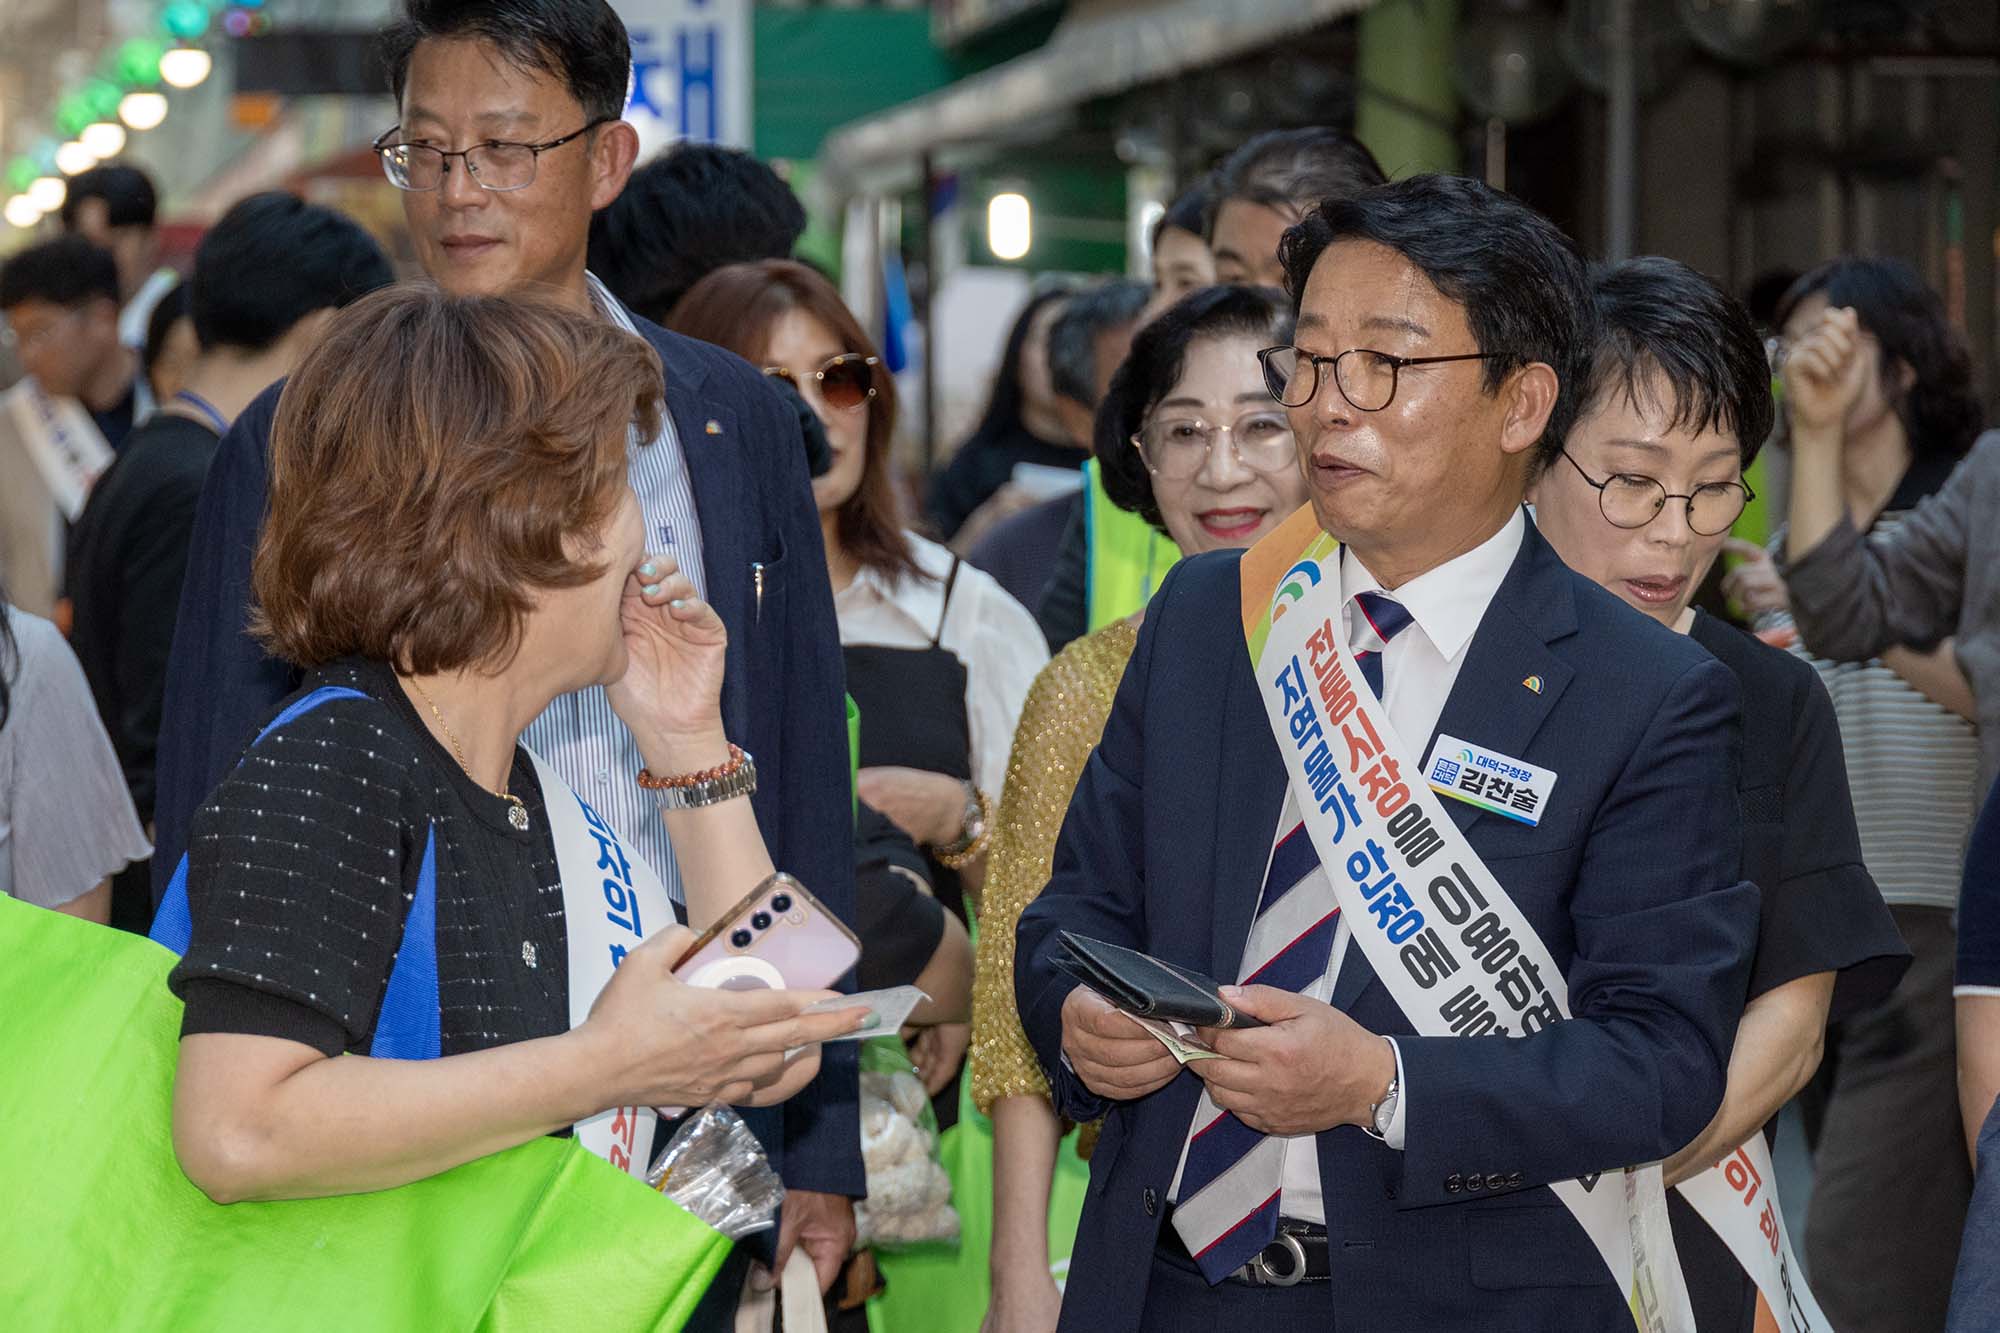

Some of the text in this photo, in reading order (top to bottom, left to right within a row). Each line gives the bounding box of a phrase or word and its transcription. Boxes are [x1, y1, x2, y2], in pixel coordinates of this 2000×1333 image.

[1305, 618, 1446, 868] 전통시장을
[1475, 755, 1532, 782] 대덕구청장
[1458, 767, 1539, 814] 김찬술
[1275, 654, 1510, 1038] 지역물가 안정에 동
[1713, 1146, 1762, 1206] 의
